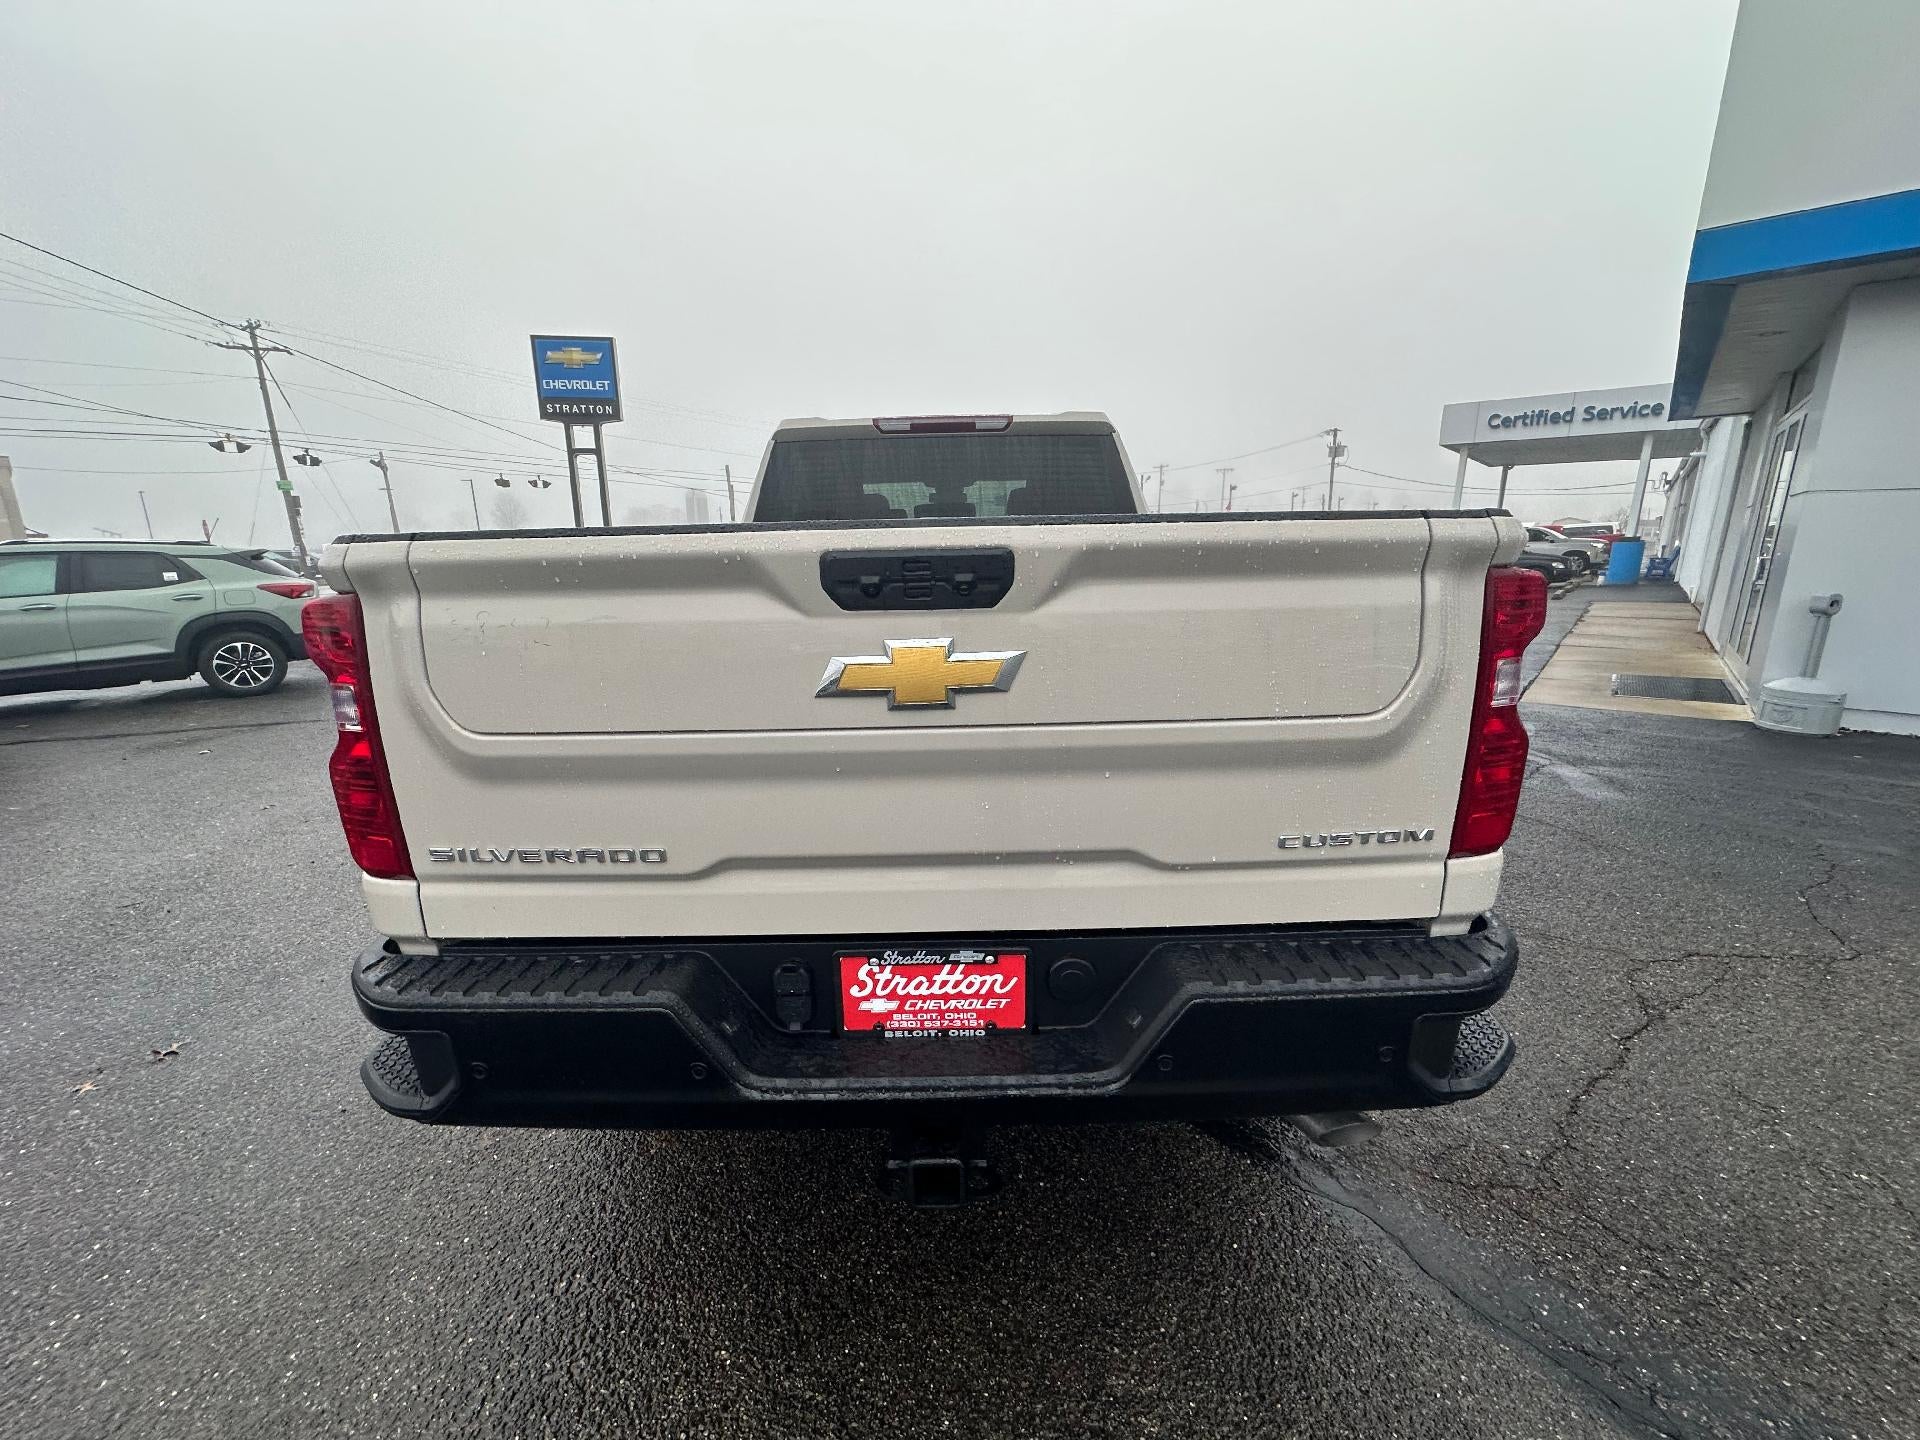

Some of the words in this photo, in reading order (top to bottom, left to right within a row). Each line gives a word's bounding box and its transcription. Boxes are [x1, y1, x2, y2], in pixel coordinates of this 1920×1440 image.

[542, 379, 610, 391] CHEVROLET
[546, 403, 613, 415] STRATTON
[1487, 406, 1576, 429] Certified
[1582, 401, 1665, 422] Service
[1277, 829, 1435, 849] CUSTOM
[428, 847, 668, 863] SILVERADO
[881, 950, 945, 966] Stratton
[850, 963, 1018, 997] Stratton
[904, 999, 1011, 1010] CHEVROLET
[892, 1013, 941, 1021] BELOIT,
[945, 1012, 977, 1020] OHIO
[886, 1021, 920, 1029] (330)
[924, 1020, 984, 1028] 537-3151
[884, 1030, 942, 1038] BELOIT,
[948, 1029, 986, 1037] OHIO
